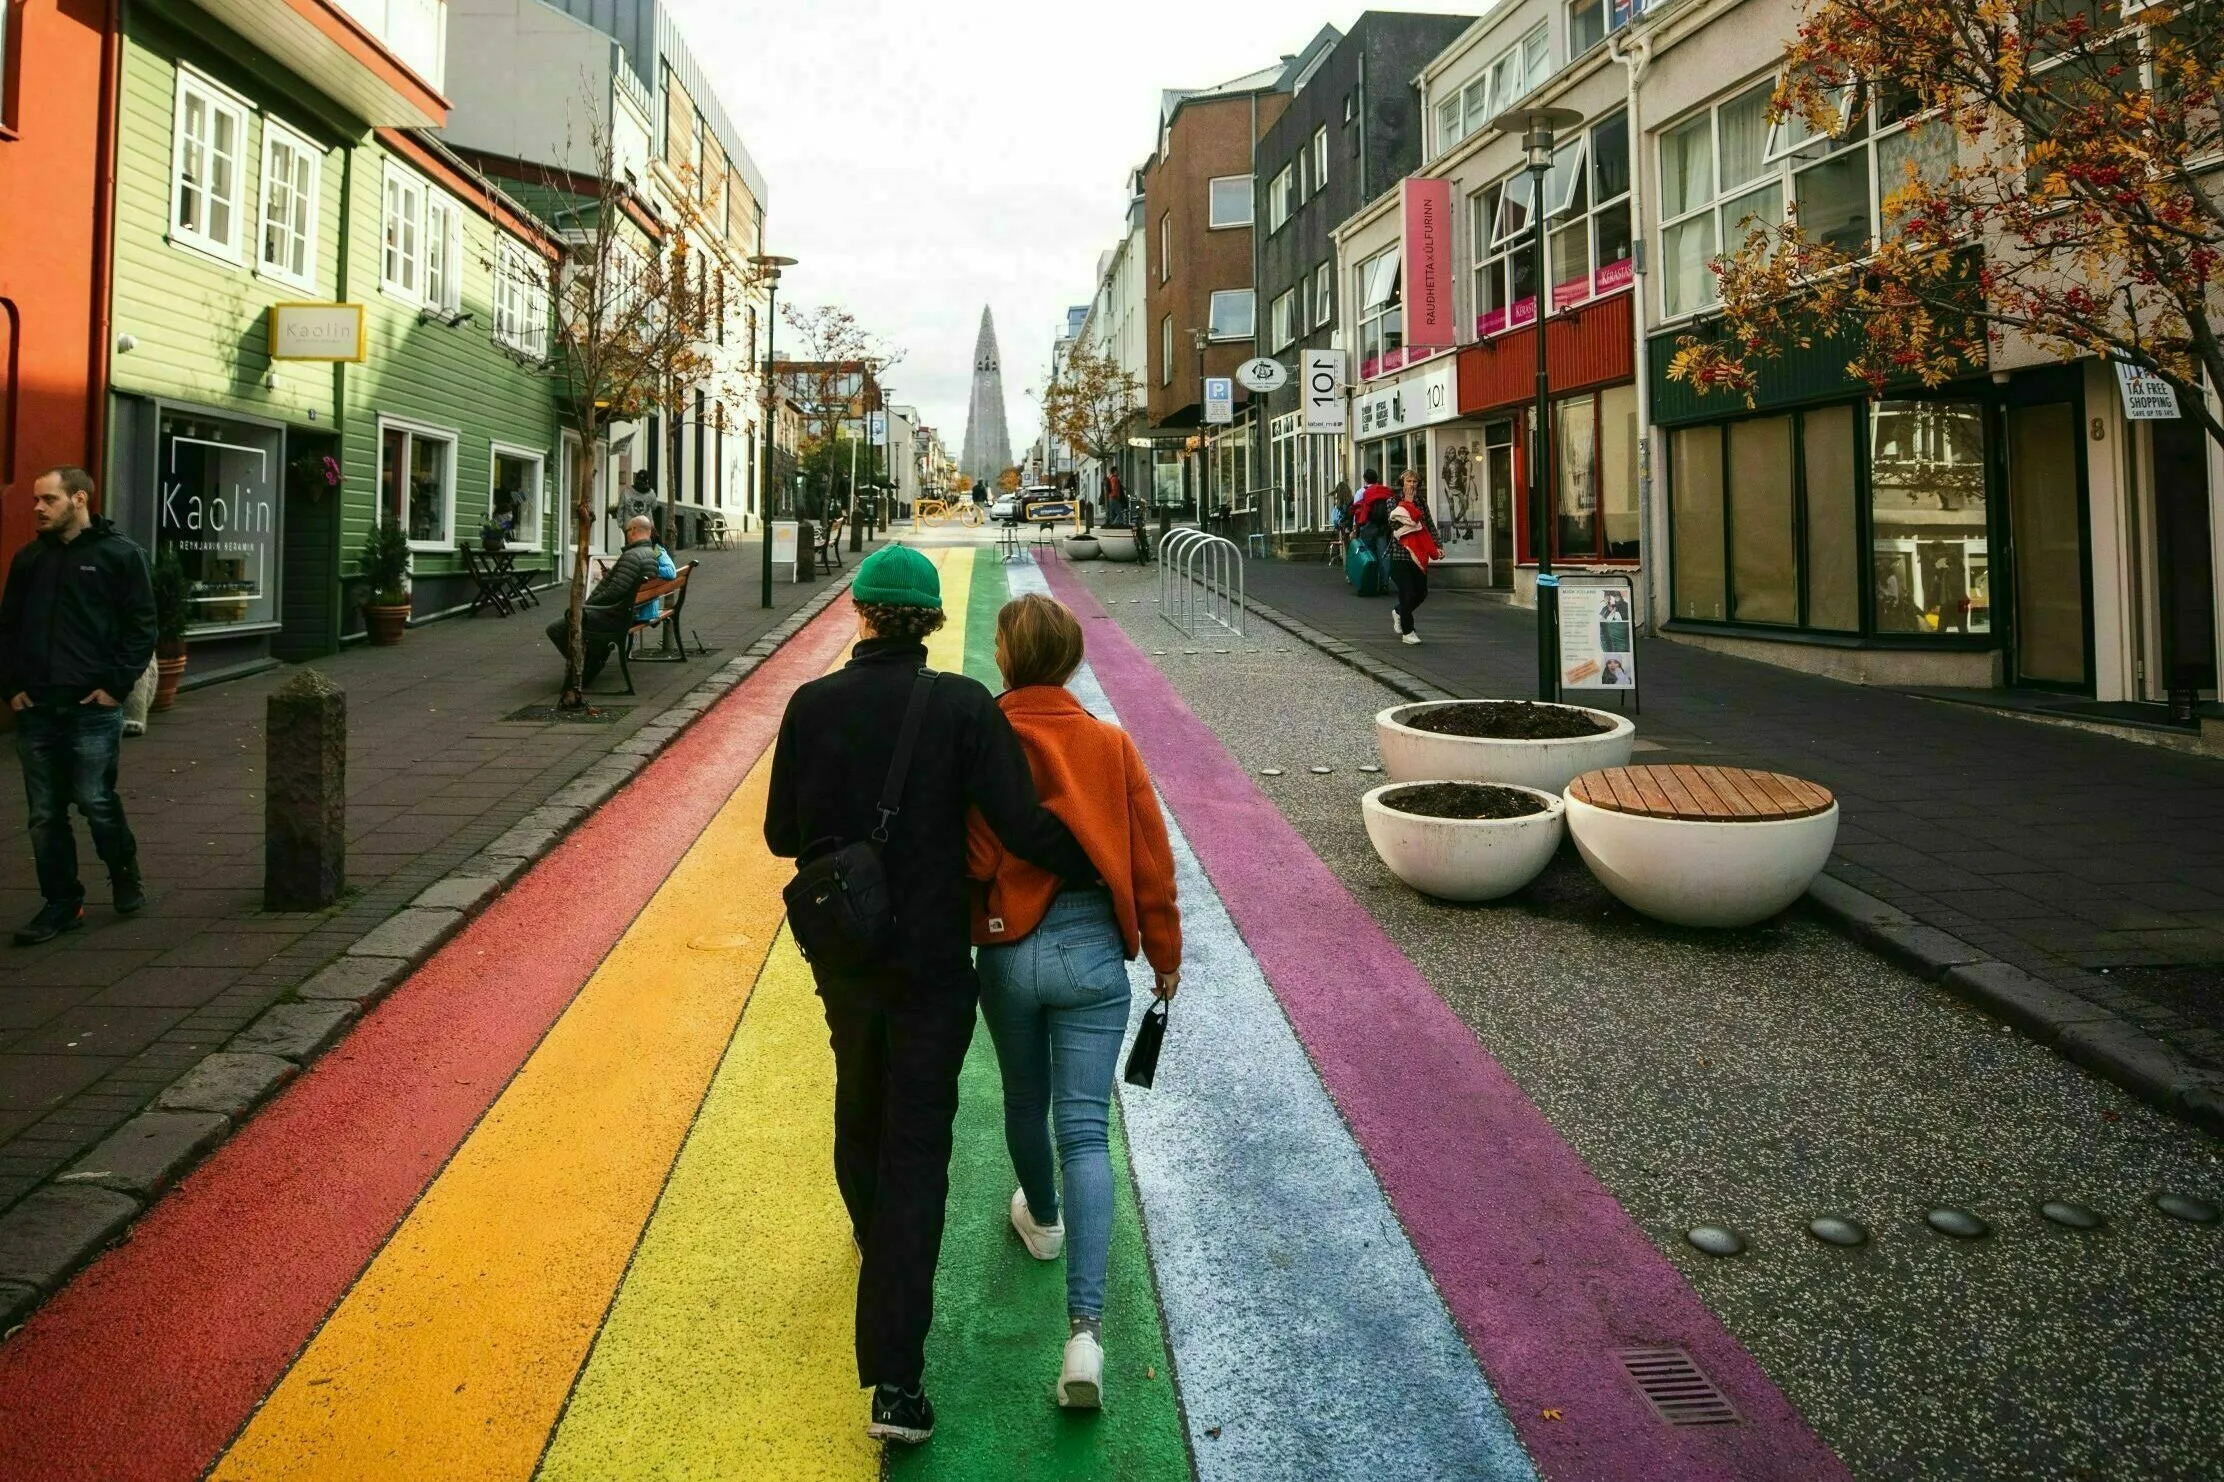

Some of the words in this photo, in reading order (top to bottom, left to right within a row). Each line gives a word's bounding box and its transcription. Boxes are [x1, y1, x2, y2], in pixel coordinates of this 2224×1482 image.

[286, 322, 350, 337] Kaolin
[1312, 358, 1334, 408] 101
[2146, 382, 2168, 395] FREE
[1426, 383, 1445, 410] 101
[2129, 396, 2173, 409] SHOPPING
[2090, 418, 2105, 441] 8
[162, 481, 270, 533] Kaolin
